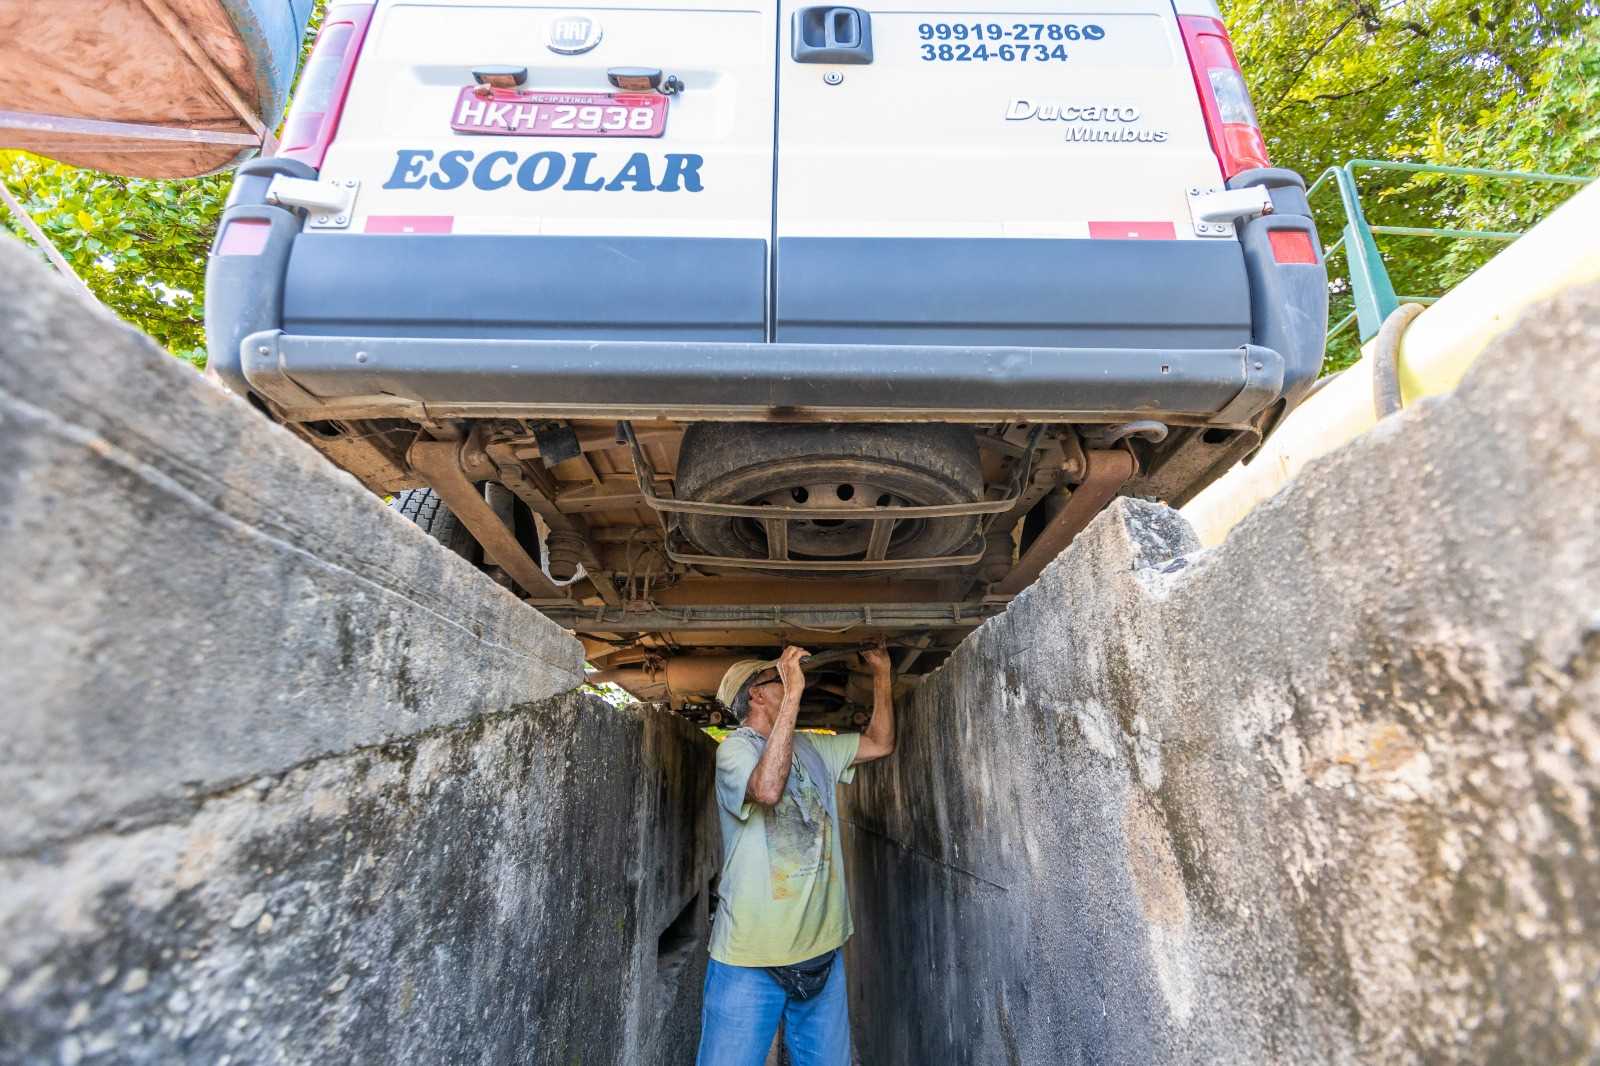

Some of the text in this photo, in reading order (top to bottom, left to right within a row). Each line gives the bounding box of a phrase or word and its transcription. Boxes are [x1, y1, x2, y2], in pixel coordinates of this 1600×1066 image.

[555, 22, 589, 41] FIAT
[918, 23, 1081, 41] 99919-2786
[921, 44, 1068, 62] 3824-6734
[457, 100, 655, 130] HKH-2938
[1005, 99, 1140, 123] Ducato
[1064, 126, 1169, 142] Minibus
[382, 150, 705, 192] ESCOLAR
